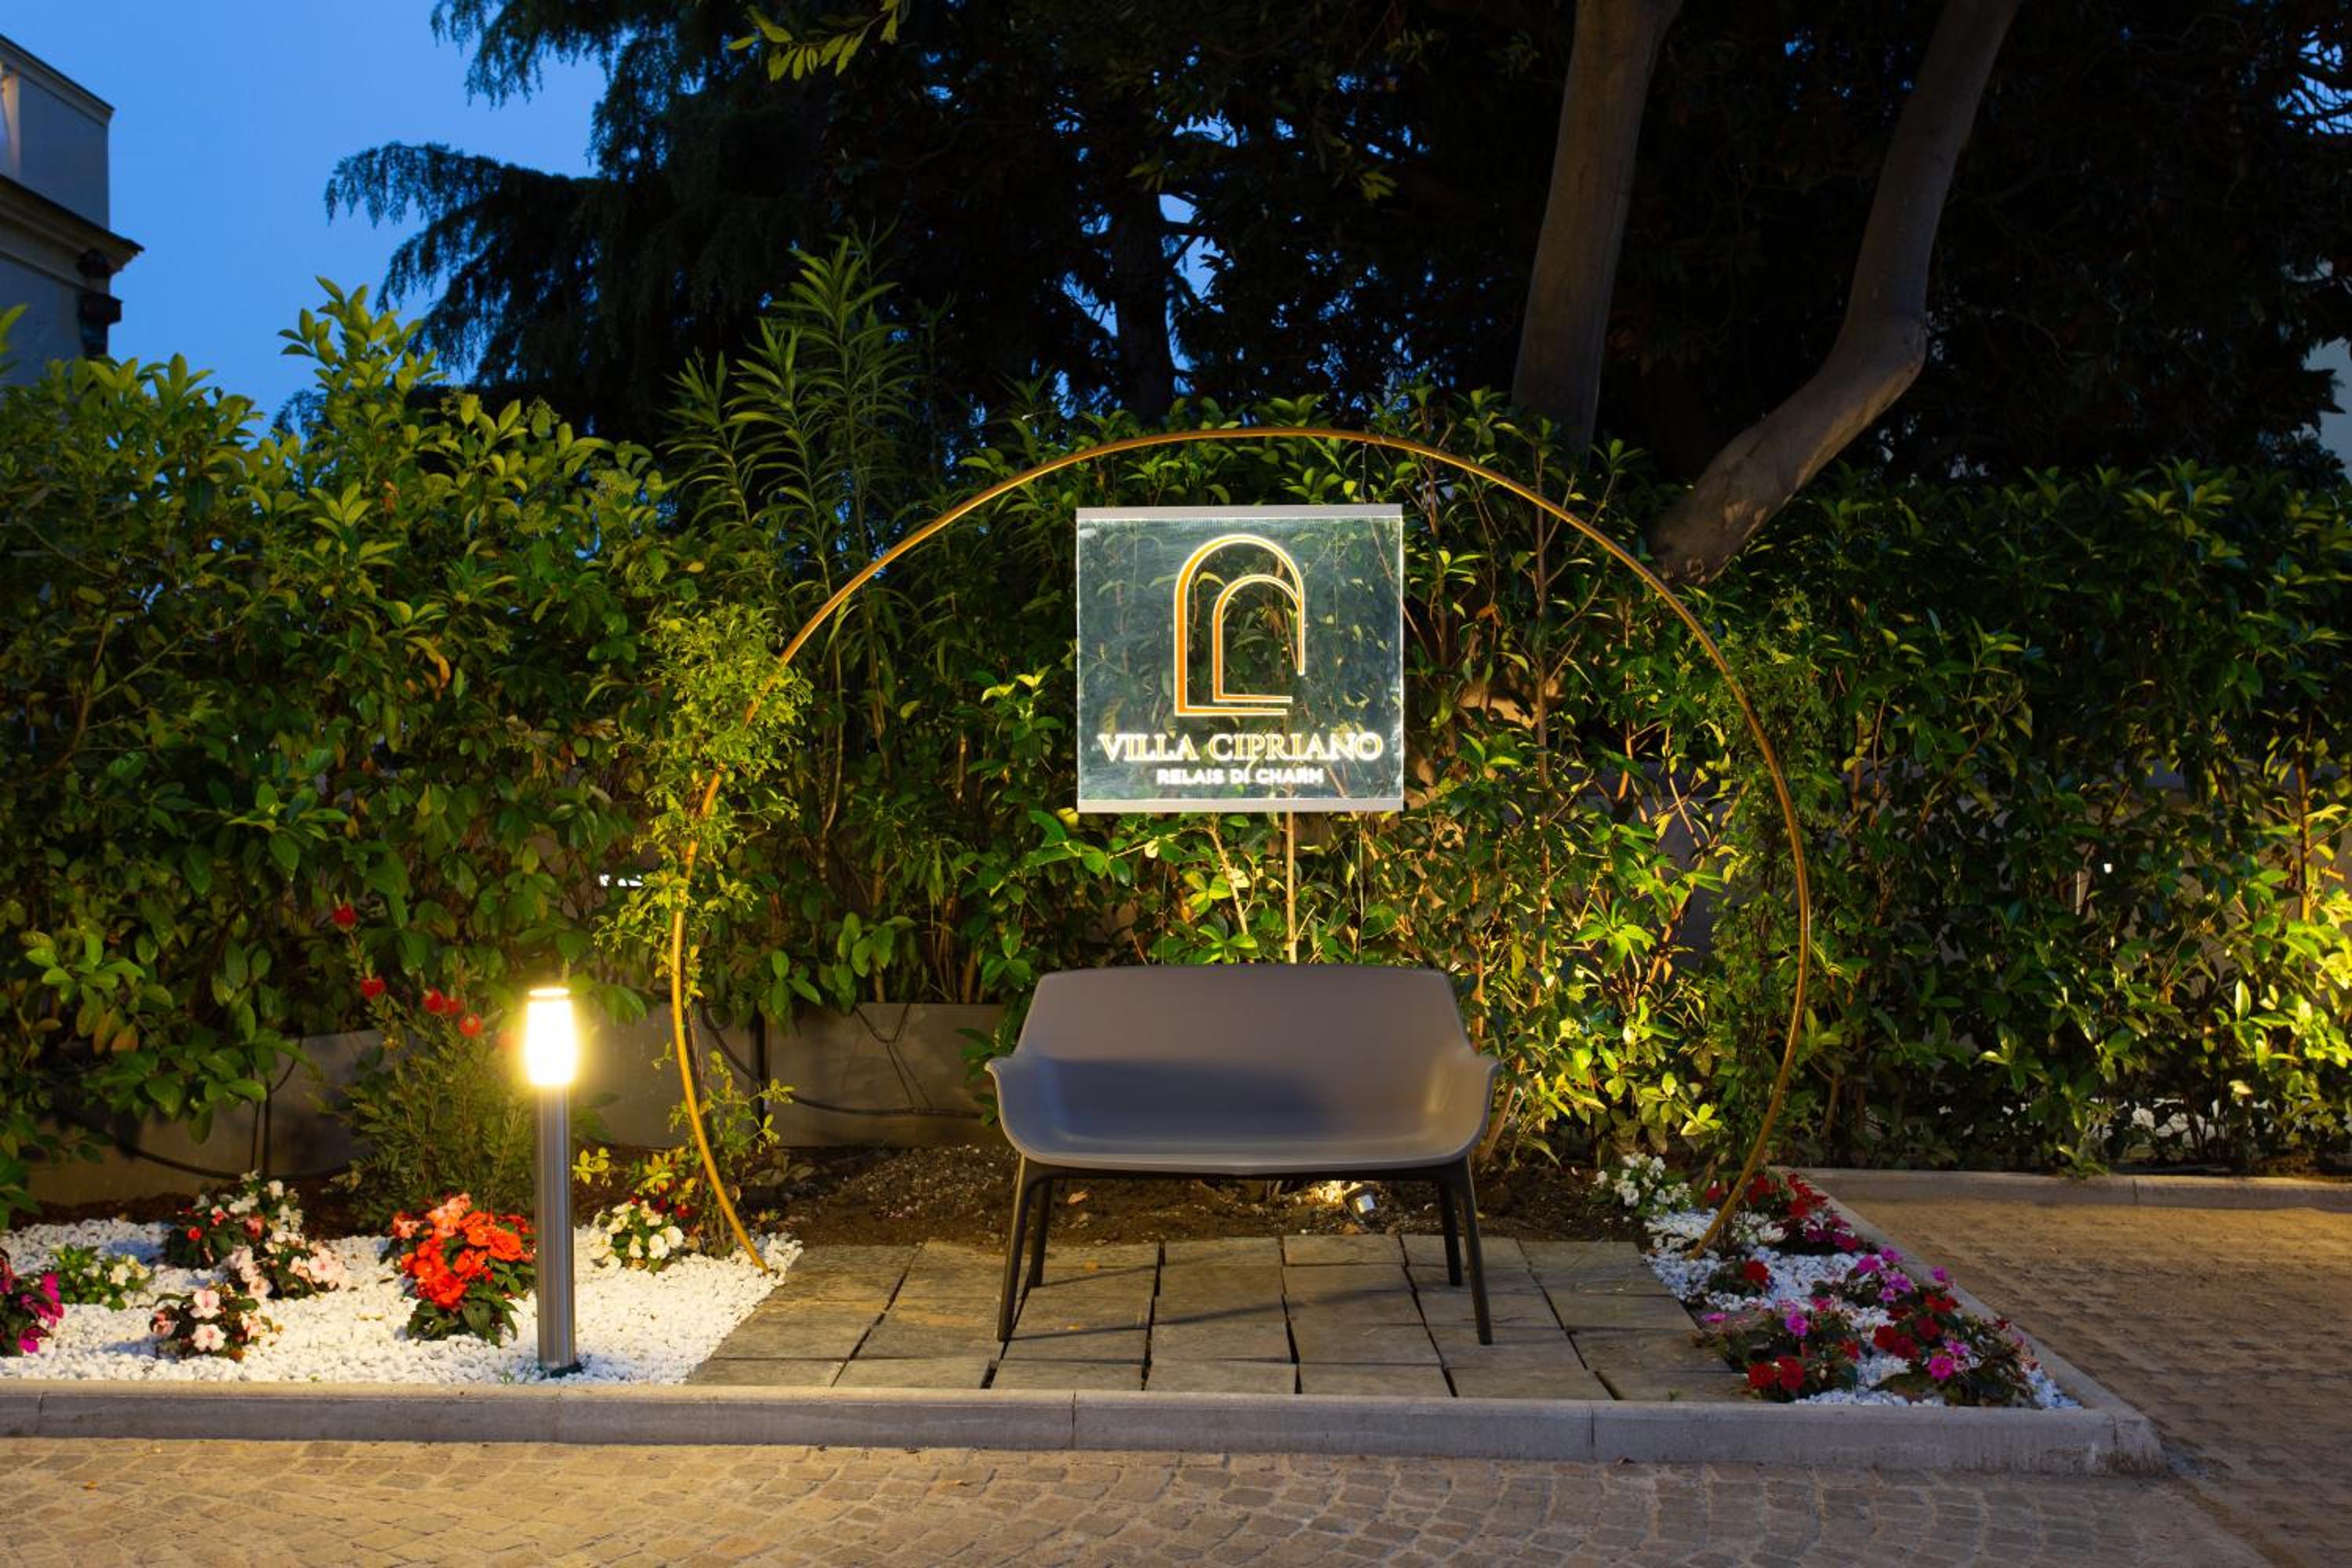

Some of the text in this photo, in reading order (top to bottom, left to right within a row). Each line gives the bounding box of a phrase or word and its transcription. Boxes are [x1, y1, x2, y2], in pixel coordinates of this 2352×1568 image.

[1098, 731, 1385, 762] VILLA CIPRIANO
[1156, 768, 1325, 785] RELAIS DI CHARM
